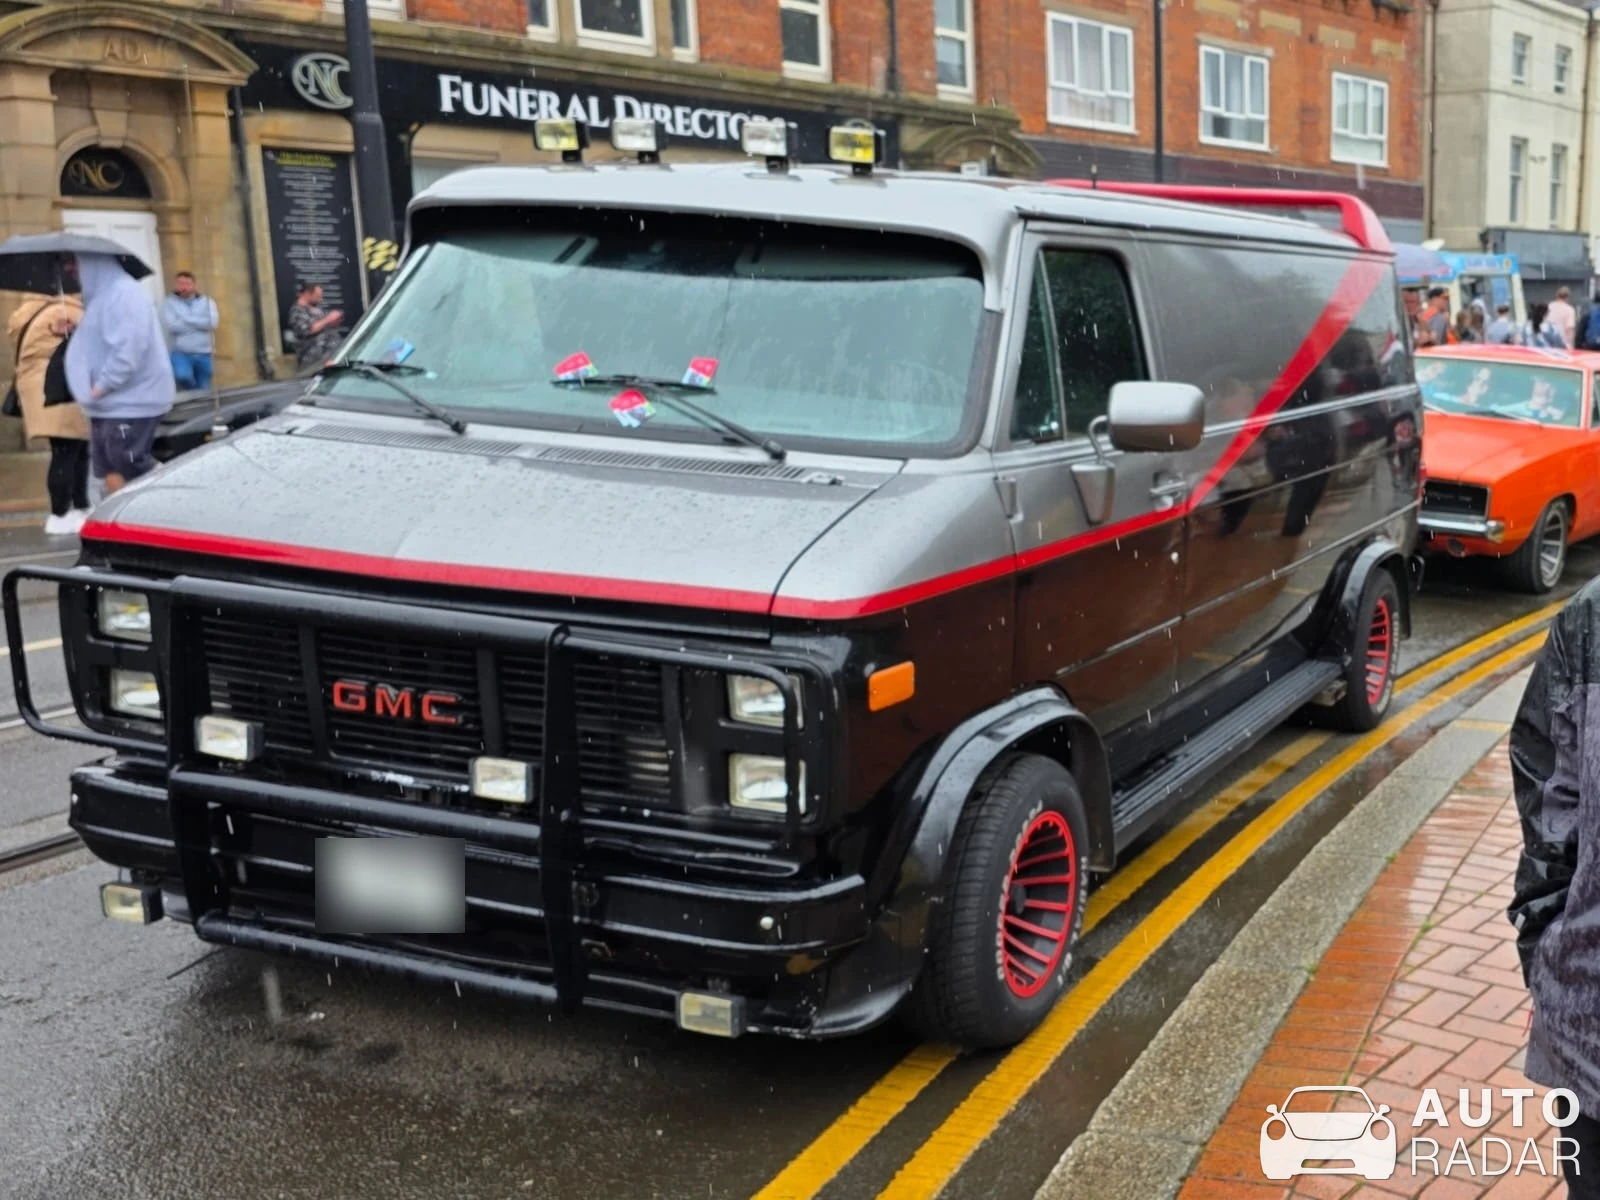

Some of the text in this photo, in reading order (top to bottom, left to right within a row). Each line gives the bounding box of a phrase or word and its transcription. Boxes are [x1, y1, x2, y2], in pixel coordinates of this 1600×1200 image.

[438, 73, 786, 141] FUNERAL DIRECTO
[332, 680, 460, 724] GMC
